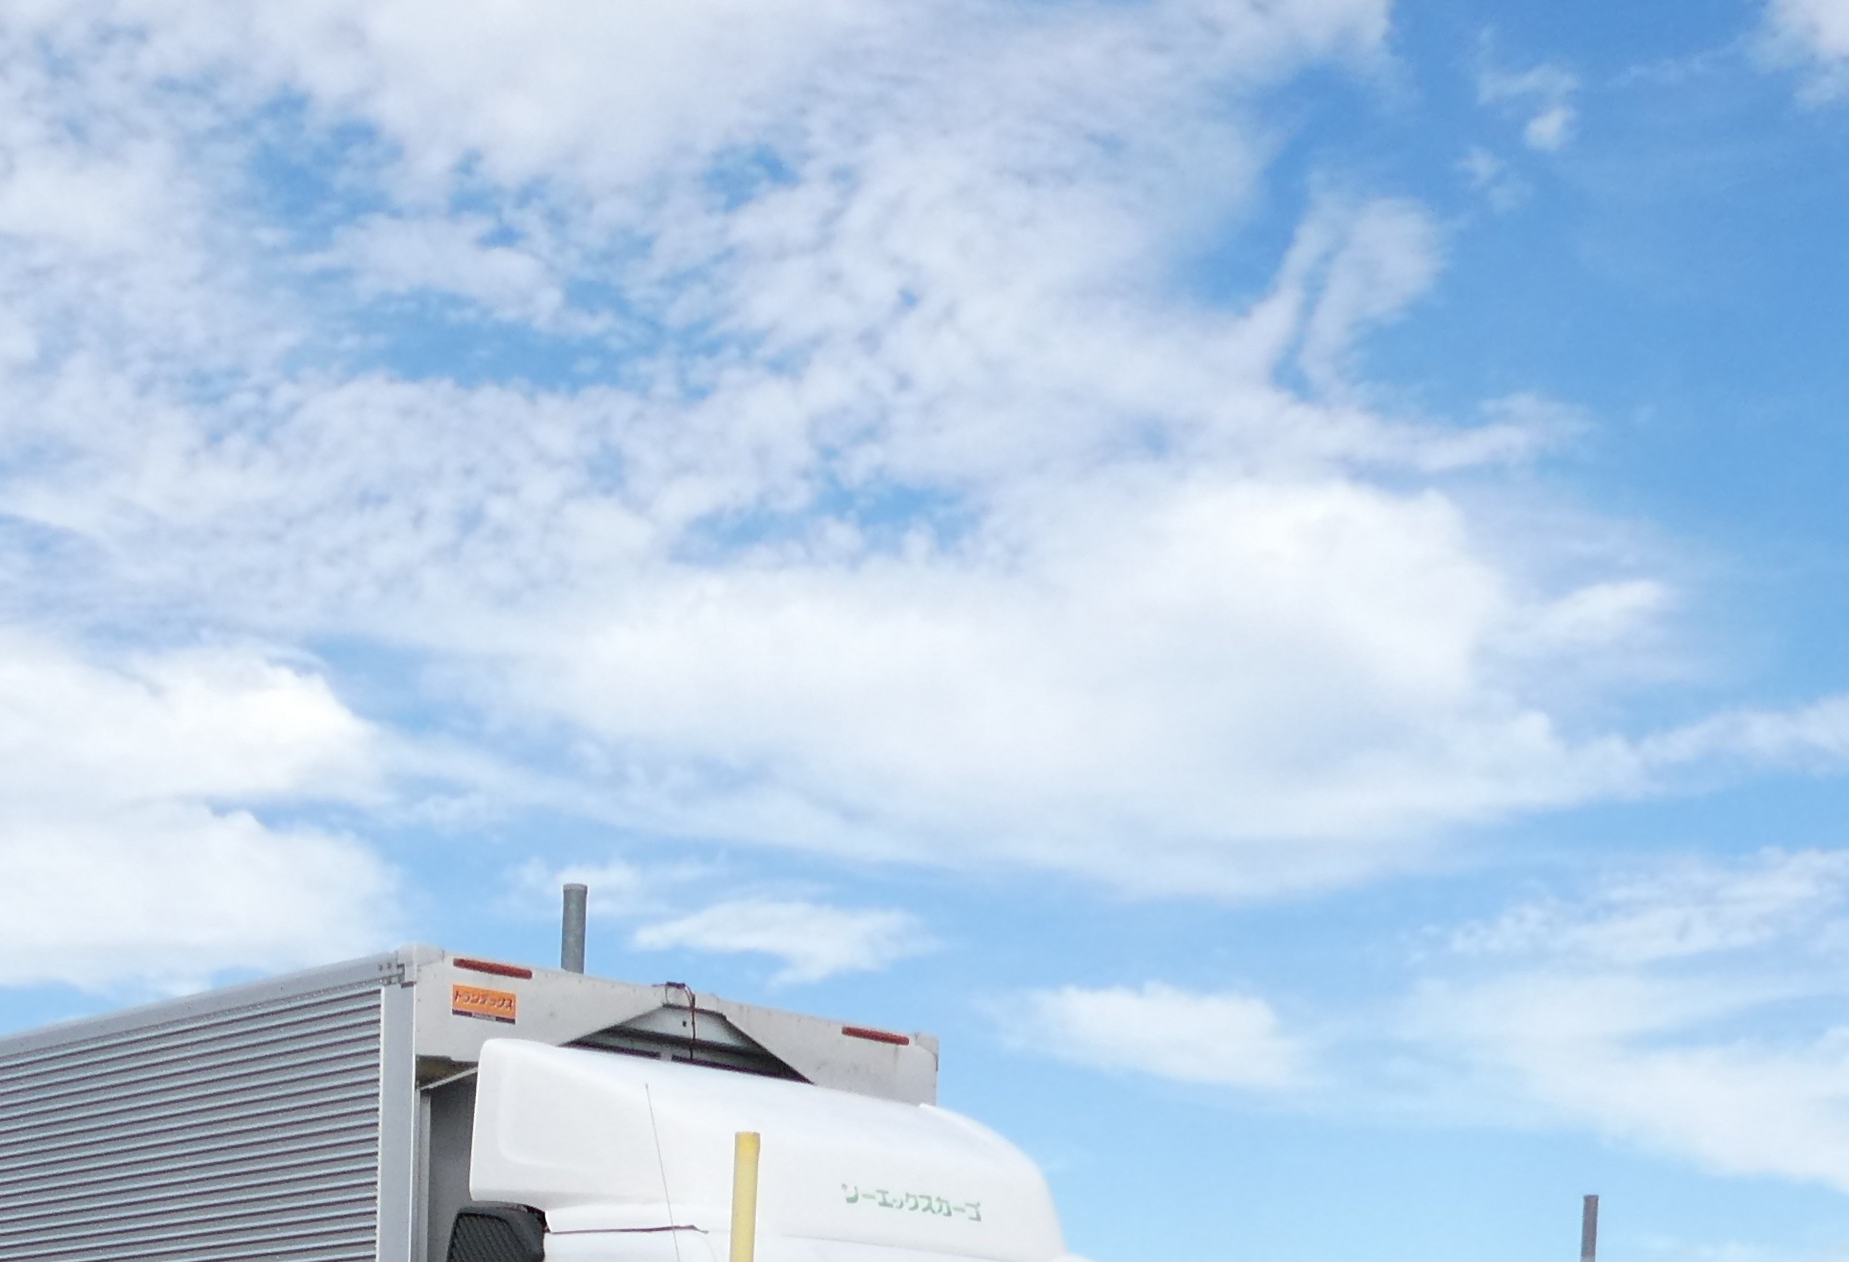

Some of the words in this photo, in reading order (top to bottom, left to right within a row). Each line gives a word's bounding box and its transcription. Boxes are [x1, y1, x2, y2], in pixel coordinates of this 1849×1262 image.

[841, 1183, 982, 1222] シーエックスカーゴ
